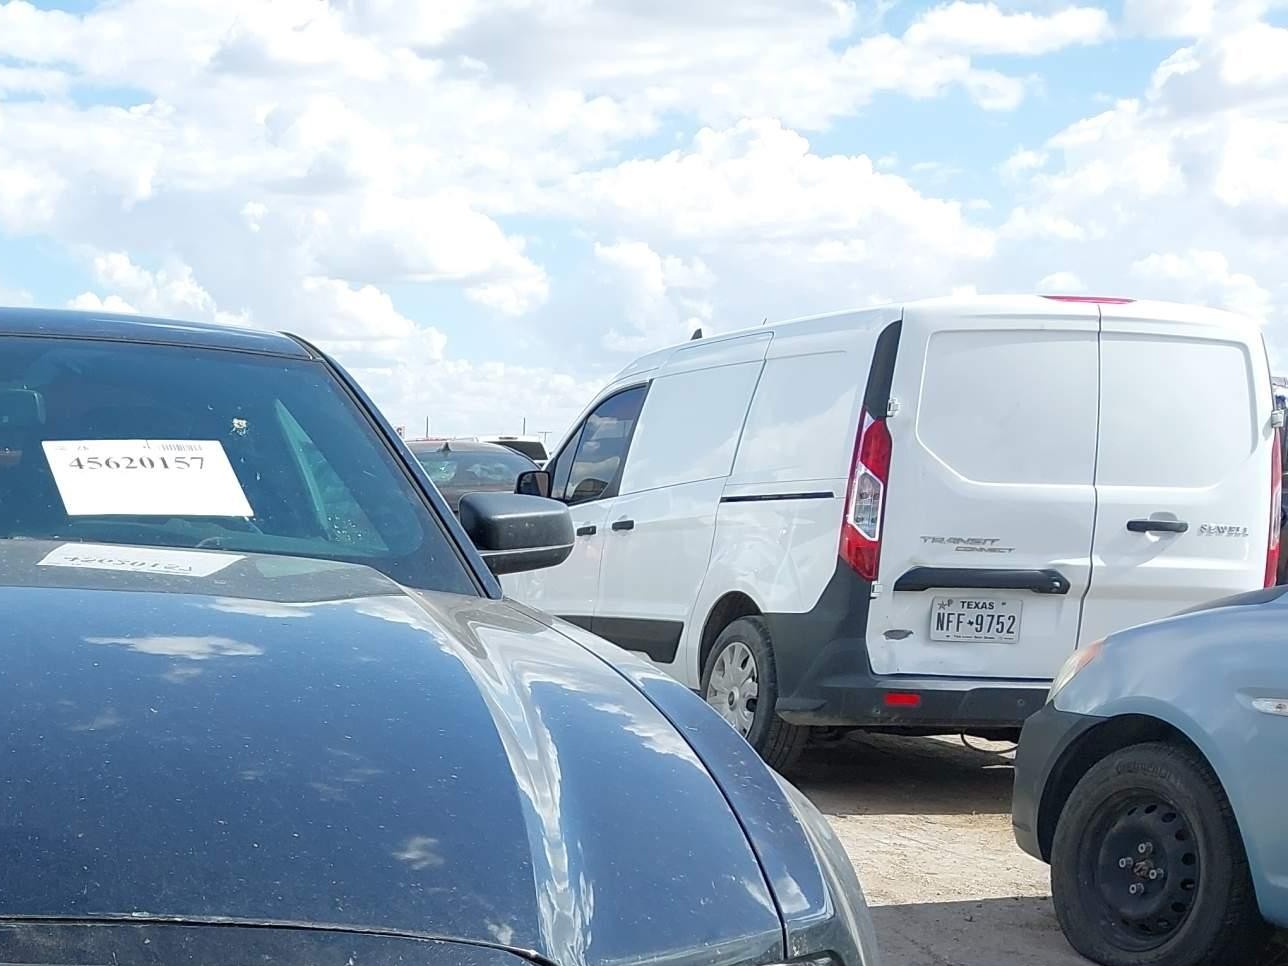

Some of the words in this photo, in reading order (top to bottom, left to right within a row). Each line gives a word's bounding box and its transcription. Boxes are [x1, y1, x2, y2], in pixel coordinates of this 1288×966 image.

[68, 456, 205, 470] 45620157
[919, 535, 1001, 546] TRANSIT
[954, 546, 1016, 554] CONNECT
[959, 600, 995, 610] TEXAS
